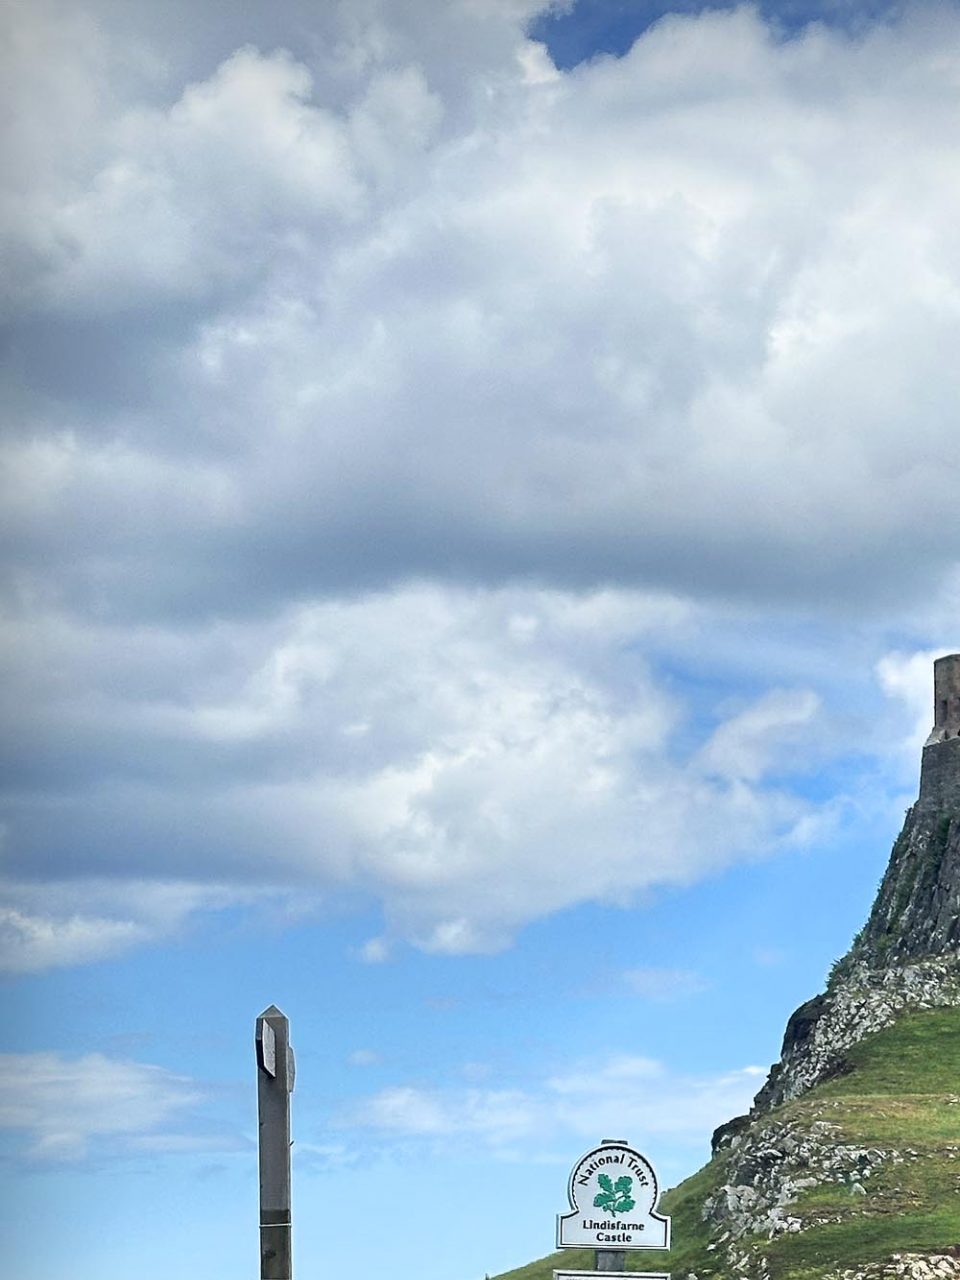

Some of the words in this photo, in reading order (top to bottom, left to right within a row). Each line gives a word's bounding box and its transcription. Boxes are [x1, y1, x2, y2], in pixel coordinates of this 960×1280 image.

[578, 1154, 625, 1186] National
[627, 1157, 649, 1186] Trust
[583, 1220, 645, 1230] Lindisfarne
[596, 1233, 632, 1242] Castle
